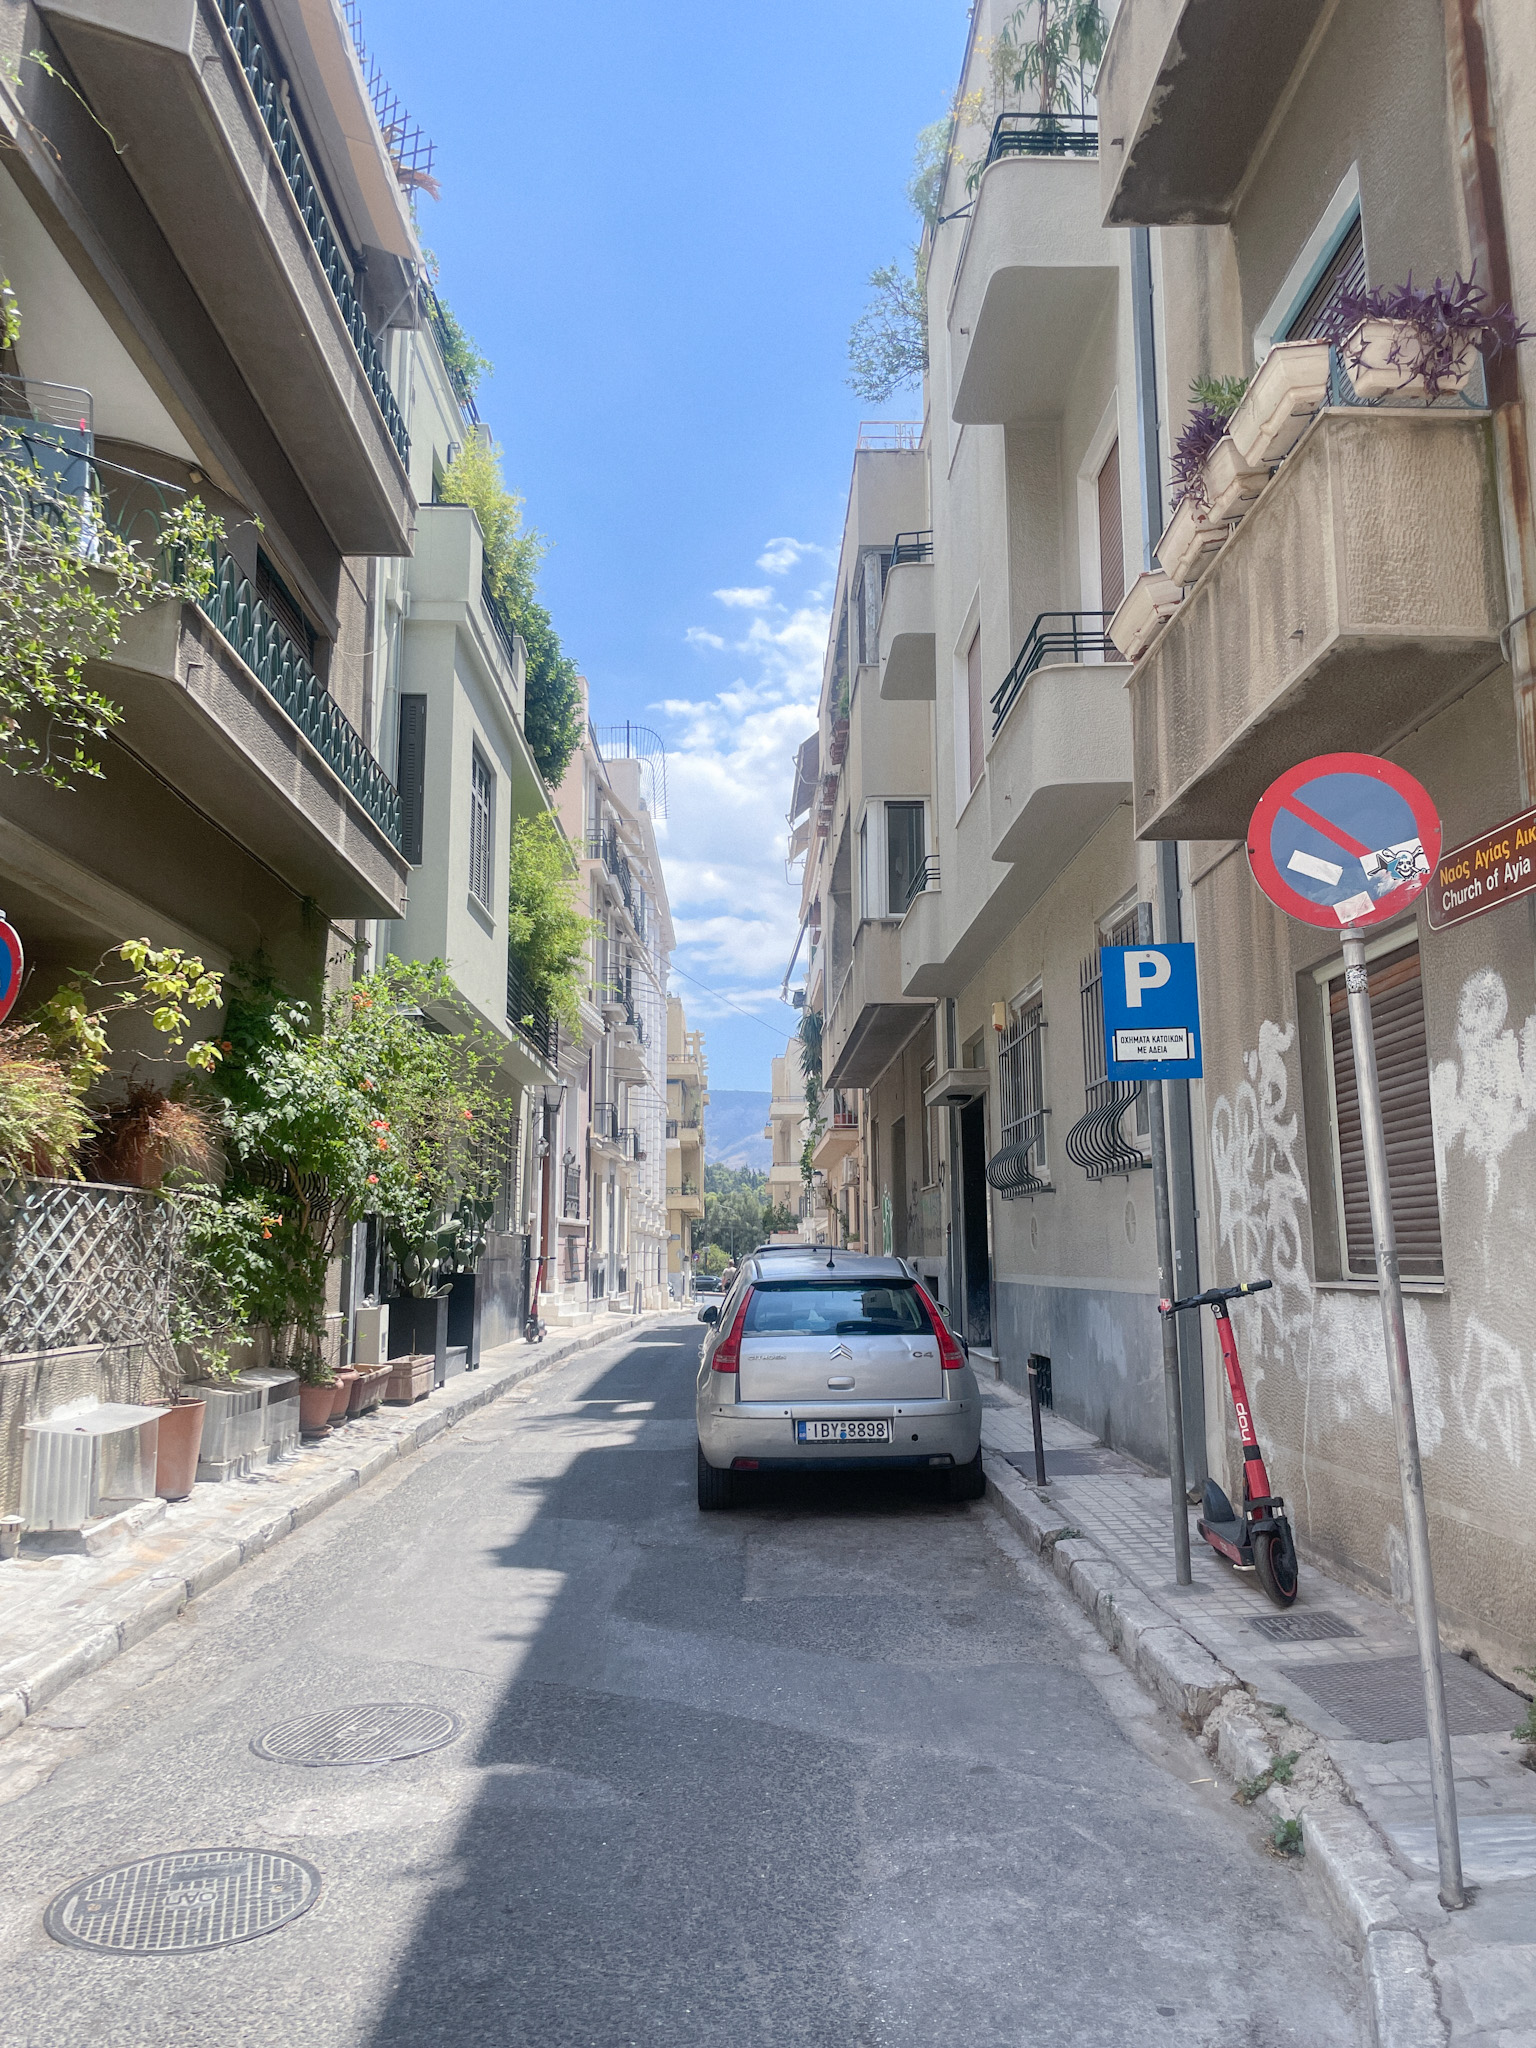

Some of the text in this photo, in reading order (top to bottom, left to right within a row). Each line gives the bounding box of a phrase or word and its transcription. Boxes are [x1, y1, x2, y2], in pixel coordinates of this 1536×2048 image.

[1440, 858, 1470, 887] Ναός
[1475, 840, 1510, 870] Αγίας
[1442, 856, 1531, 911] Church of Ayia
[1124, 950, 1171, 1008] P
